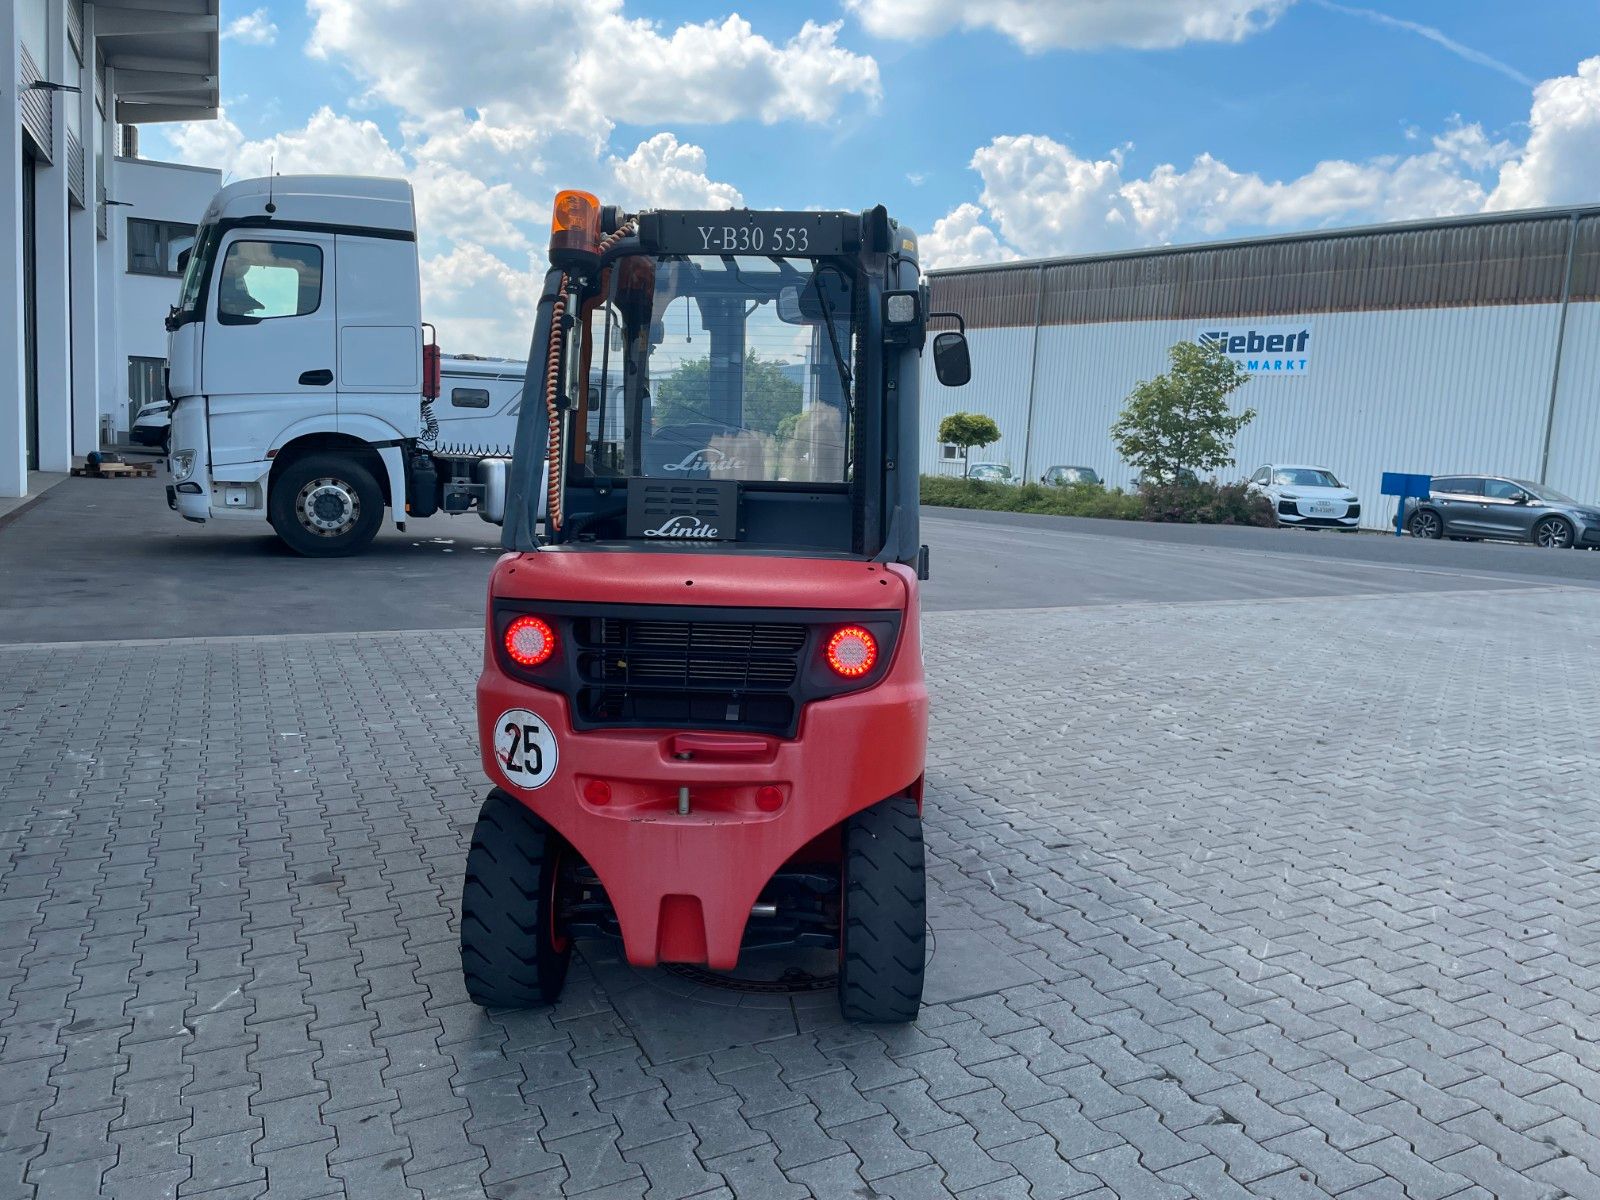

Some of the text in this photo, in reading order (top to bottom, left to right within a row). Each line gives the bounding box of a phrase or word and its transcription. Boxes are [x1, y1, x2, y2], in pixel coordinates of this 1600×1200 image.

[697, 226, 809, 252] Y-B30 553
[662, 448, 745, 471] Linde
[643, 515, 718, 538] Linde
[504, 722, 543, 775] 25
